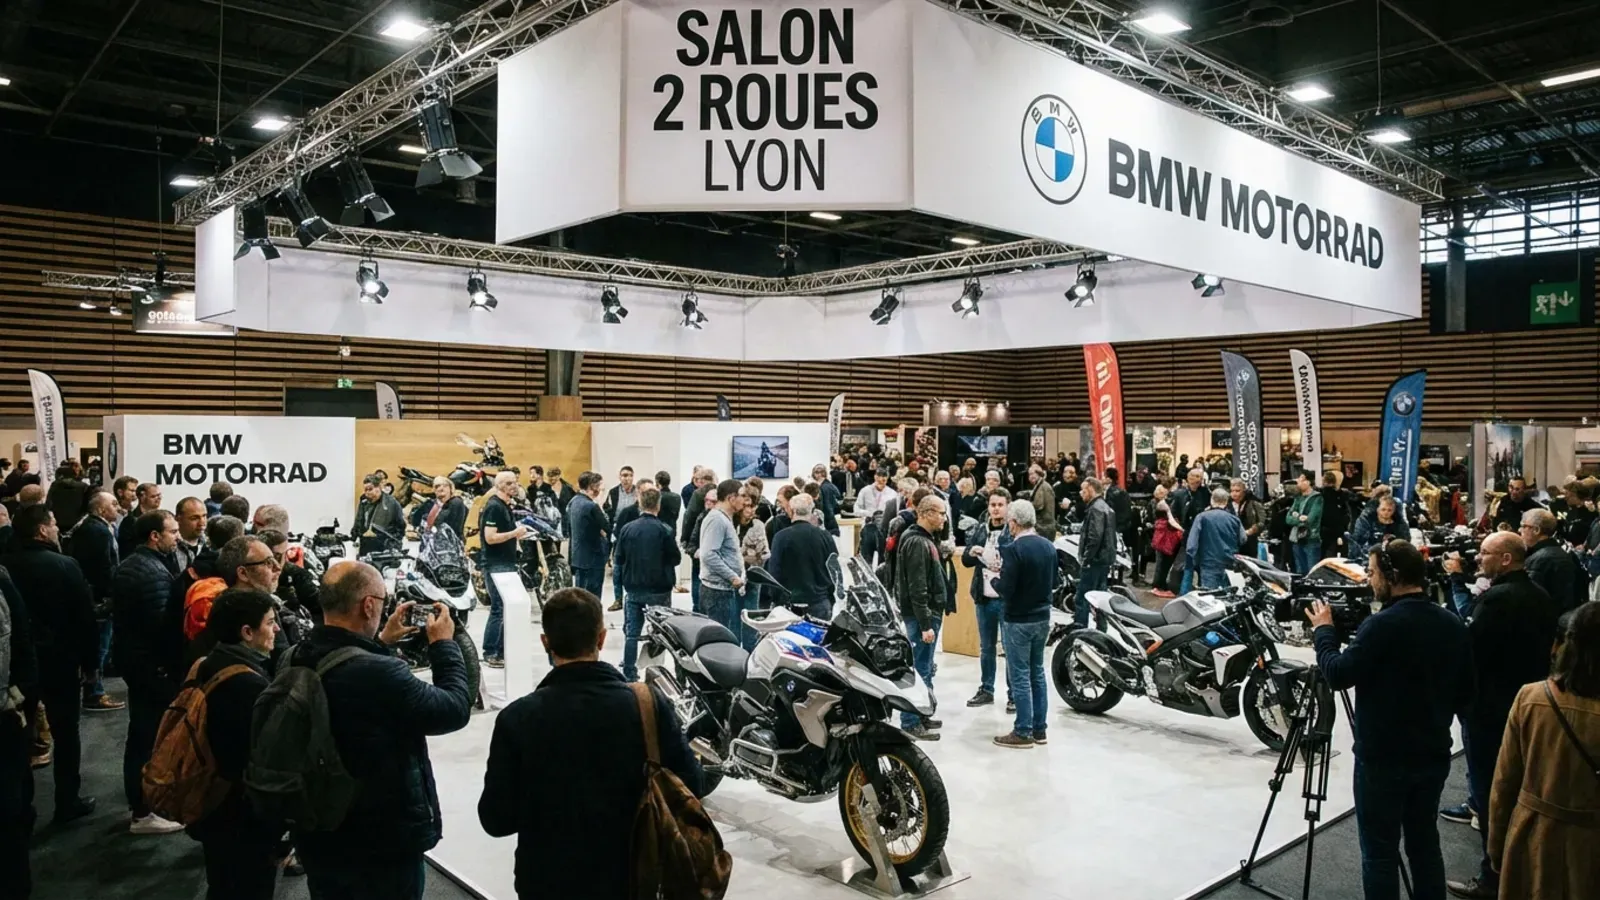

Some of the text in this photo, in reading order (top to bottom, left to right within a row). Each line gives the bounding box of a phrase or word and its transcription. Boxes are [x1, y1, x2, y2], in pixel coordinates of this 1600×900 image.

[676, 8, 854, 67] SALON
[653, 72, 879, 131] 2 ROUES
[705, 138, 825, 192] LYON
[1109, 140, 1384, 270] BMW MOTORRAD
[163, 433, 243, 455] BMW
[154, 462, 328, 486] MOTORRAD
